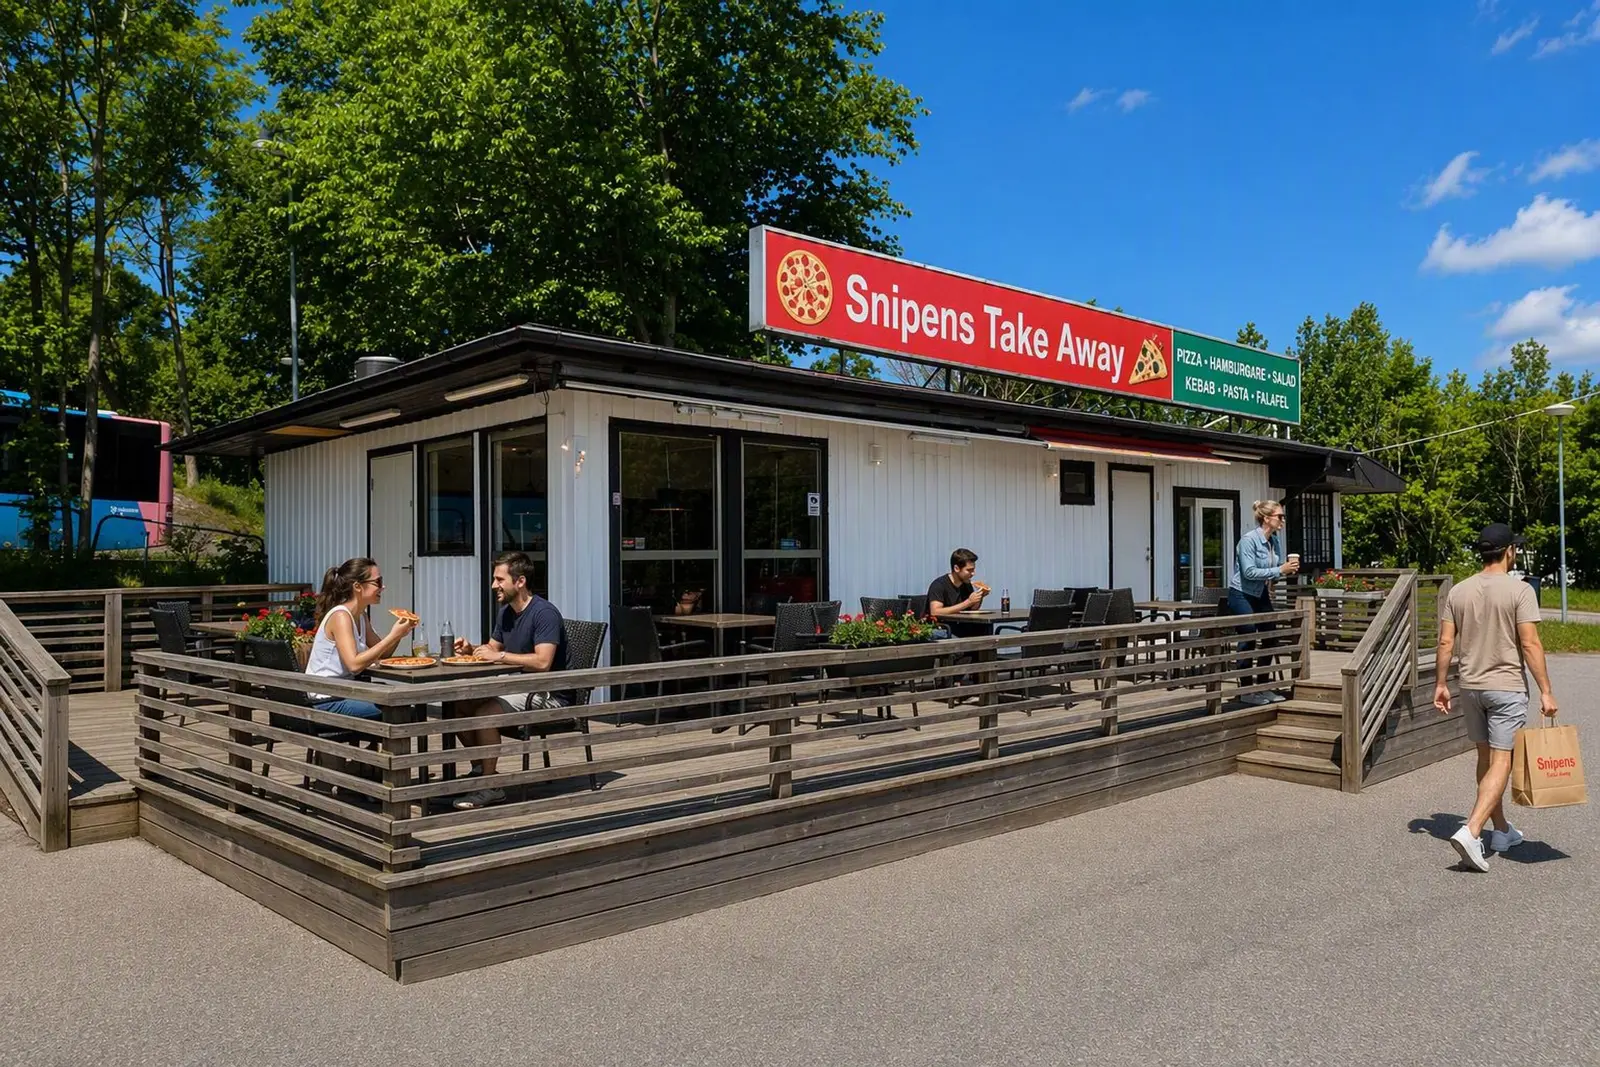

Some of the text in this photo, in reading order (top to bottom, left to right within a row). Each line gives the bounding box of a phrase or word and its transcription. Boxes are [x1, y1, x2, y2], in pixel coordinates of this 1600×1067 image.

[845, 274, 1125, 384] Snipens Take Away
[1177, 348, 1296, 388] PIZZA HAMBURGARE SALAD
[1185, 376, 1289, 409] KEBAB PASTA FALAFEL
[1537, 756, 1576, 771] Snipens
